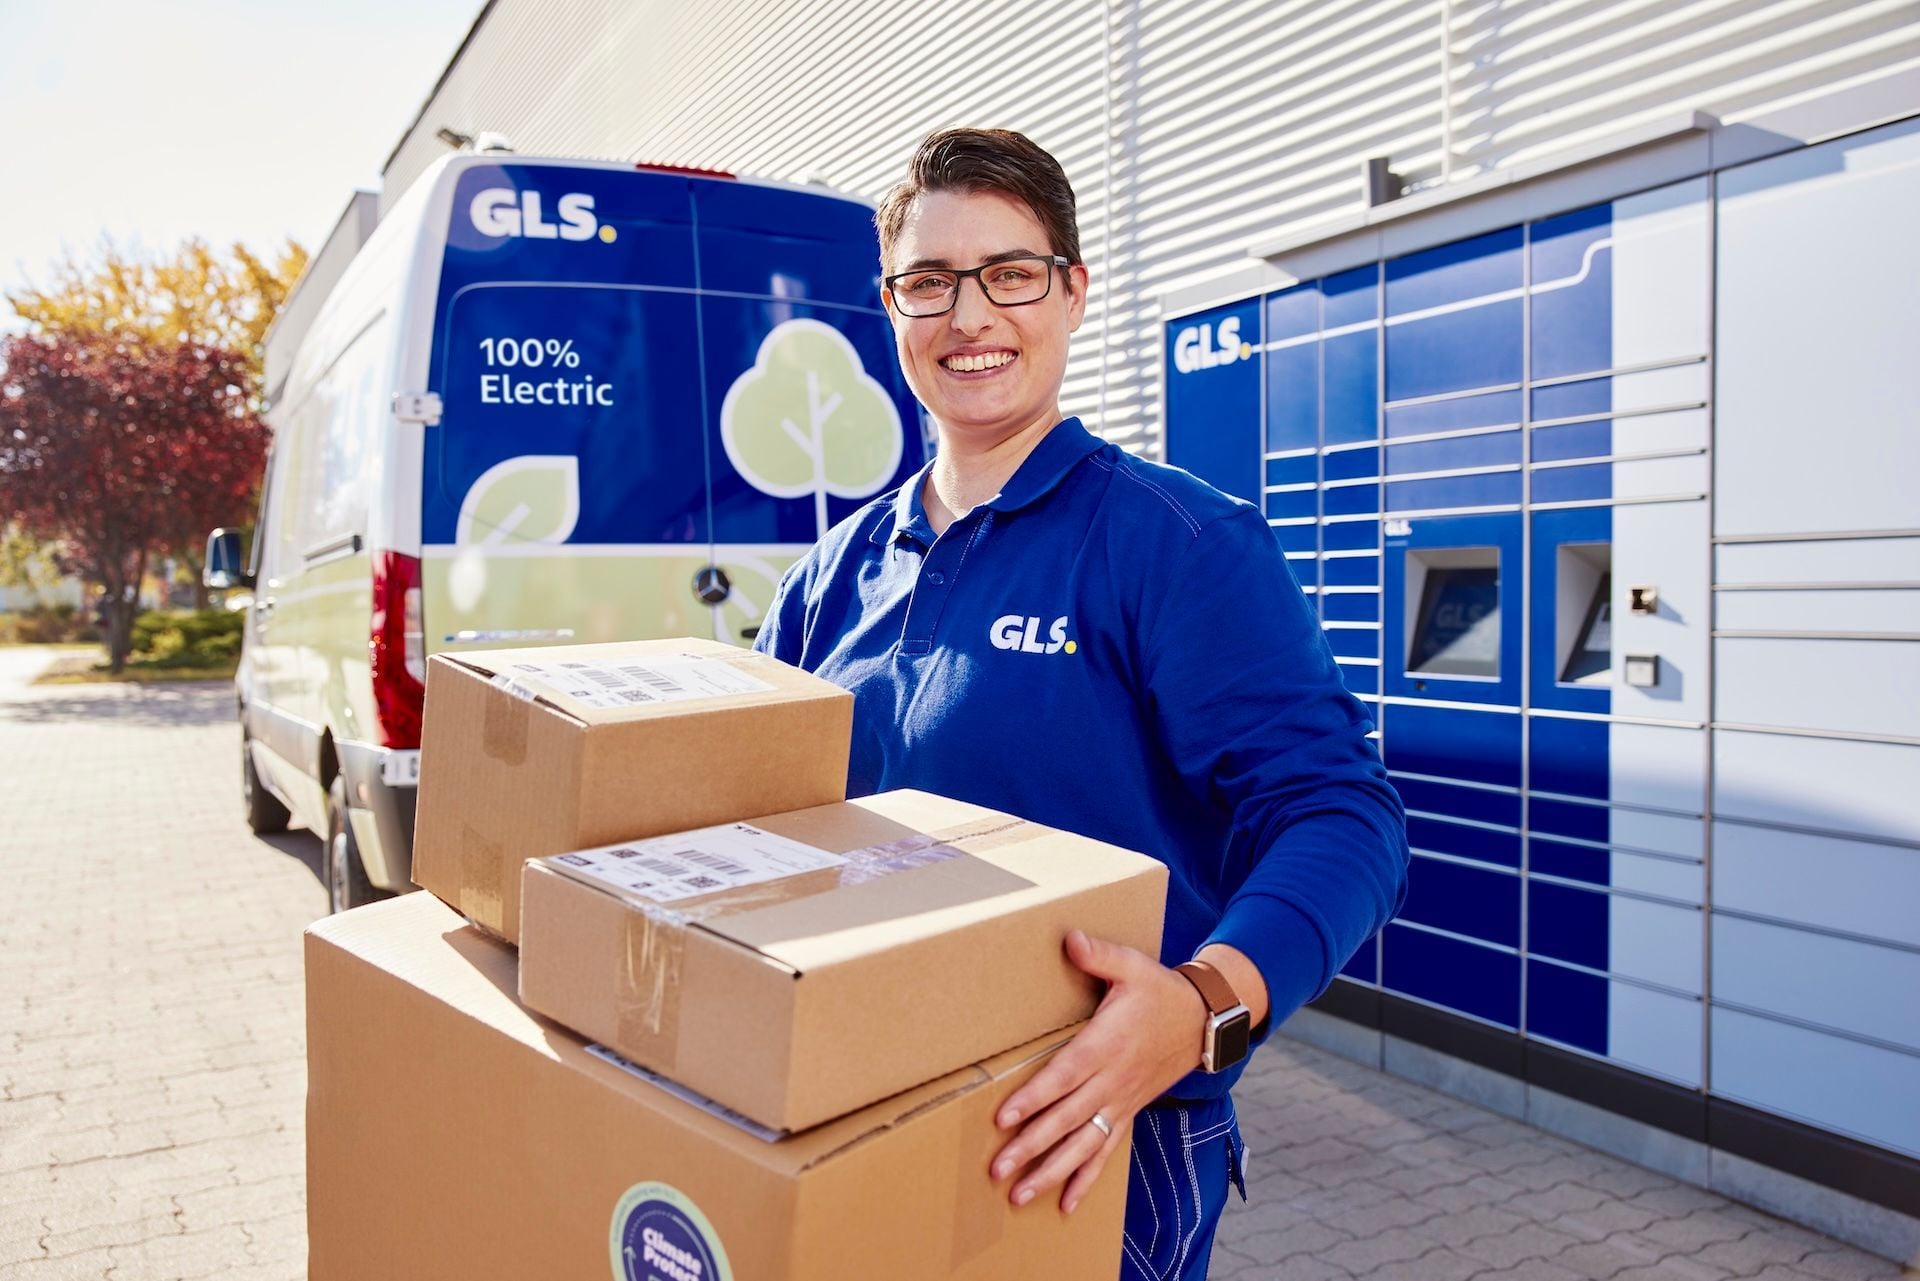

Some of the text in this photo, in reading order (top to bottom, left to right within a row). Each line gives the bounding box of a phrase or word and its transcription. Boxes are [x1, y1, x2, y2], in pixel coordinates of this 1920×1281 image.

[469, 188, 617, 243] GLS.
[480, 338, 580, 368] 100%
[1174, 316, 1253, 374] GLS.
[480, 374, 614, 406] Electric
[989, 614, 1077, 655] GLS.
[642, 1227, 702, 1277] Climate
